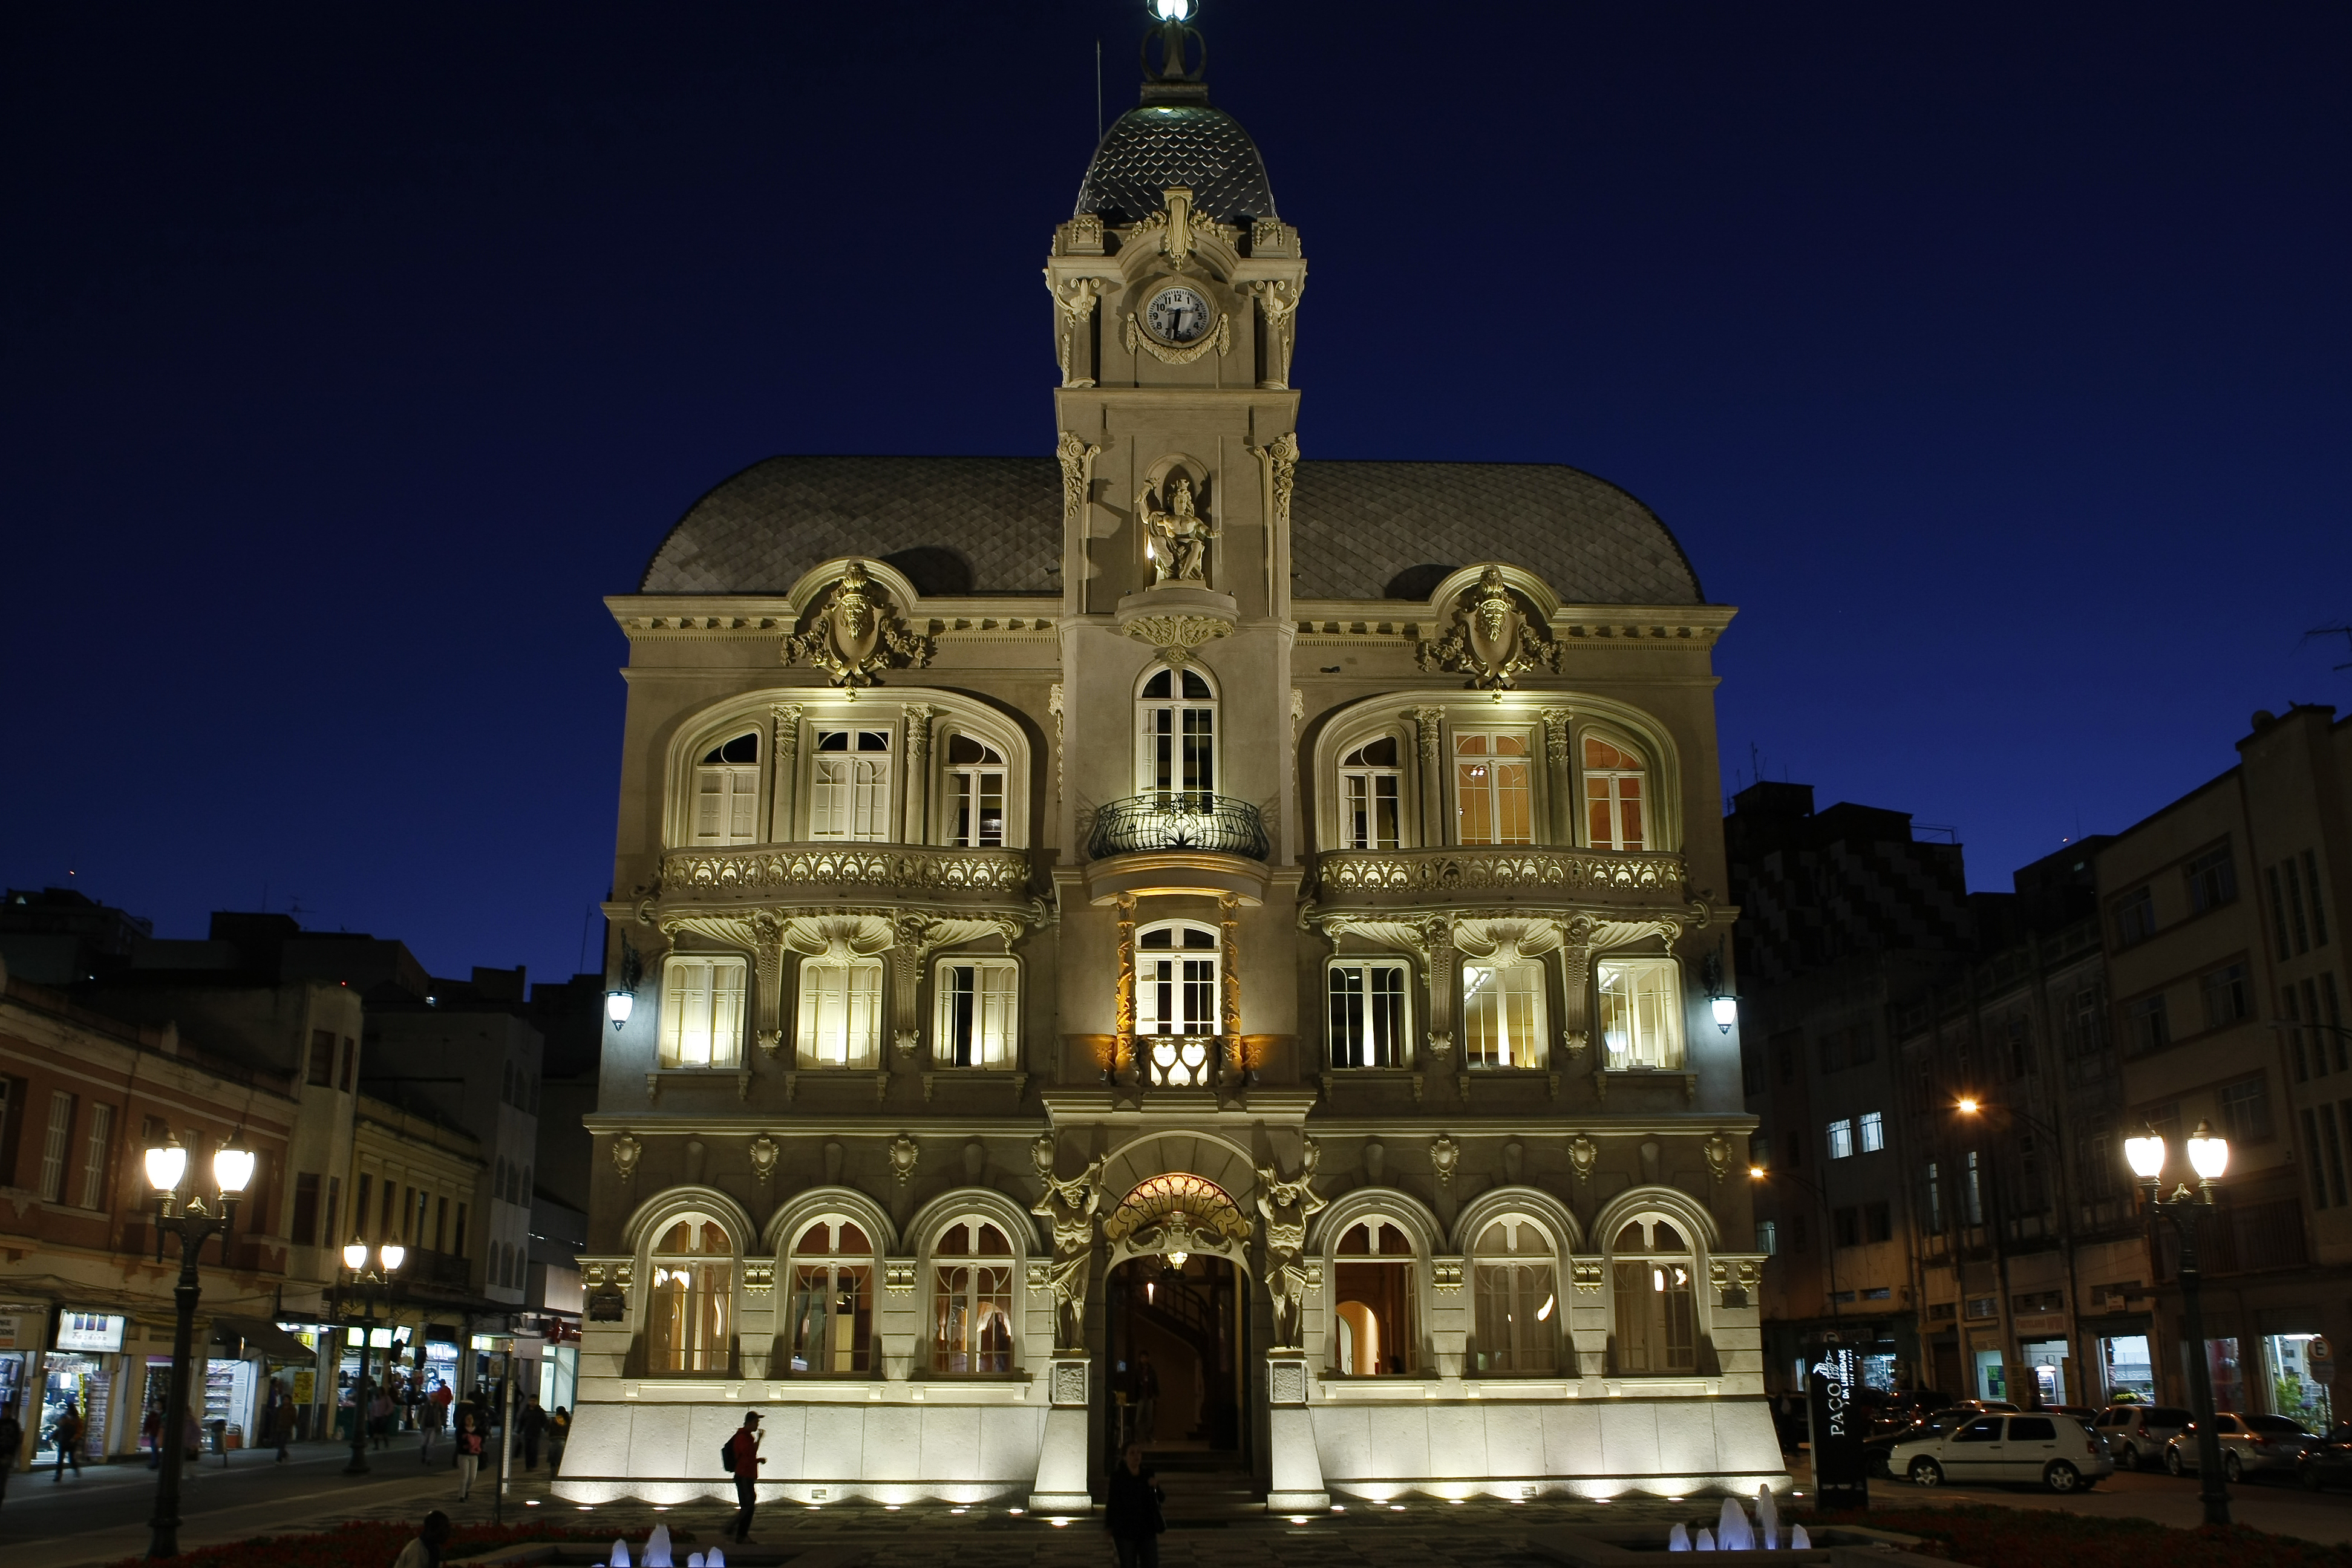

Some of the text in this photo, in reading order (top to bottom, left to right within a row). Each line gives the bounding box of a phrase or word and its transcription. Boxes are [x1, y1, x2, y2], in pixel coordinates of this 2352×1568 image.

[1156, 303, 1165, 312] 10
[1195, 303, 1200, 312] 2
[2314, 1342, 2324, 1356] E
[1838, 1349, 1850, 1399] DA LIBERDADE
[1827, 1383, 1851, 1436] PAÇO
